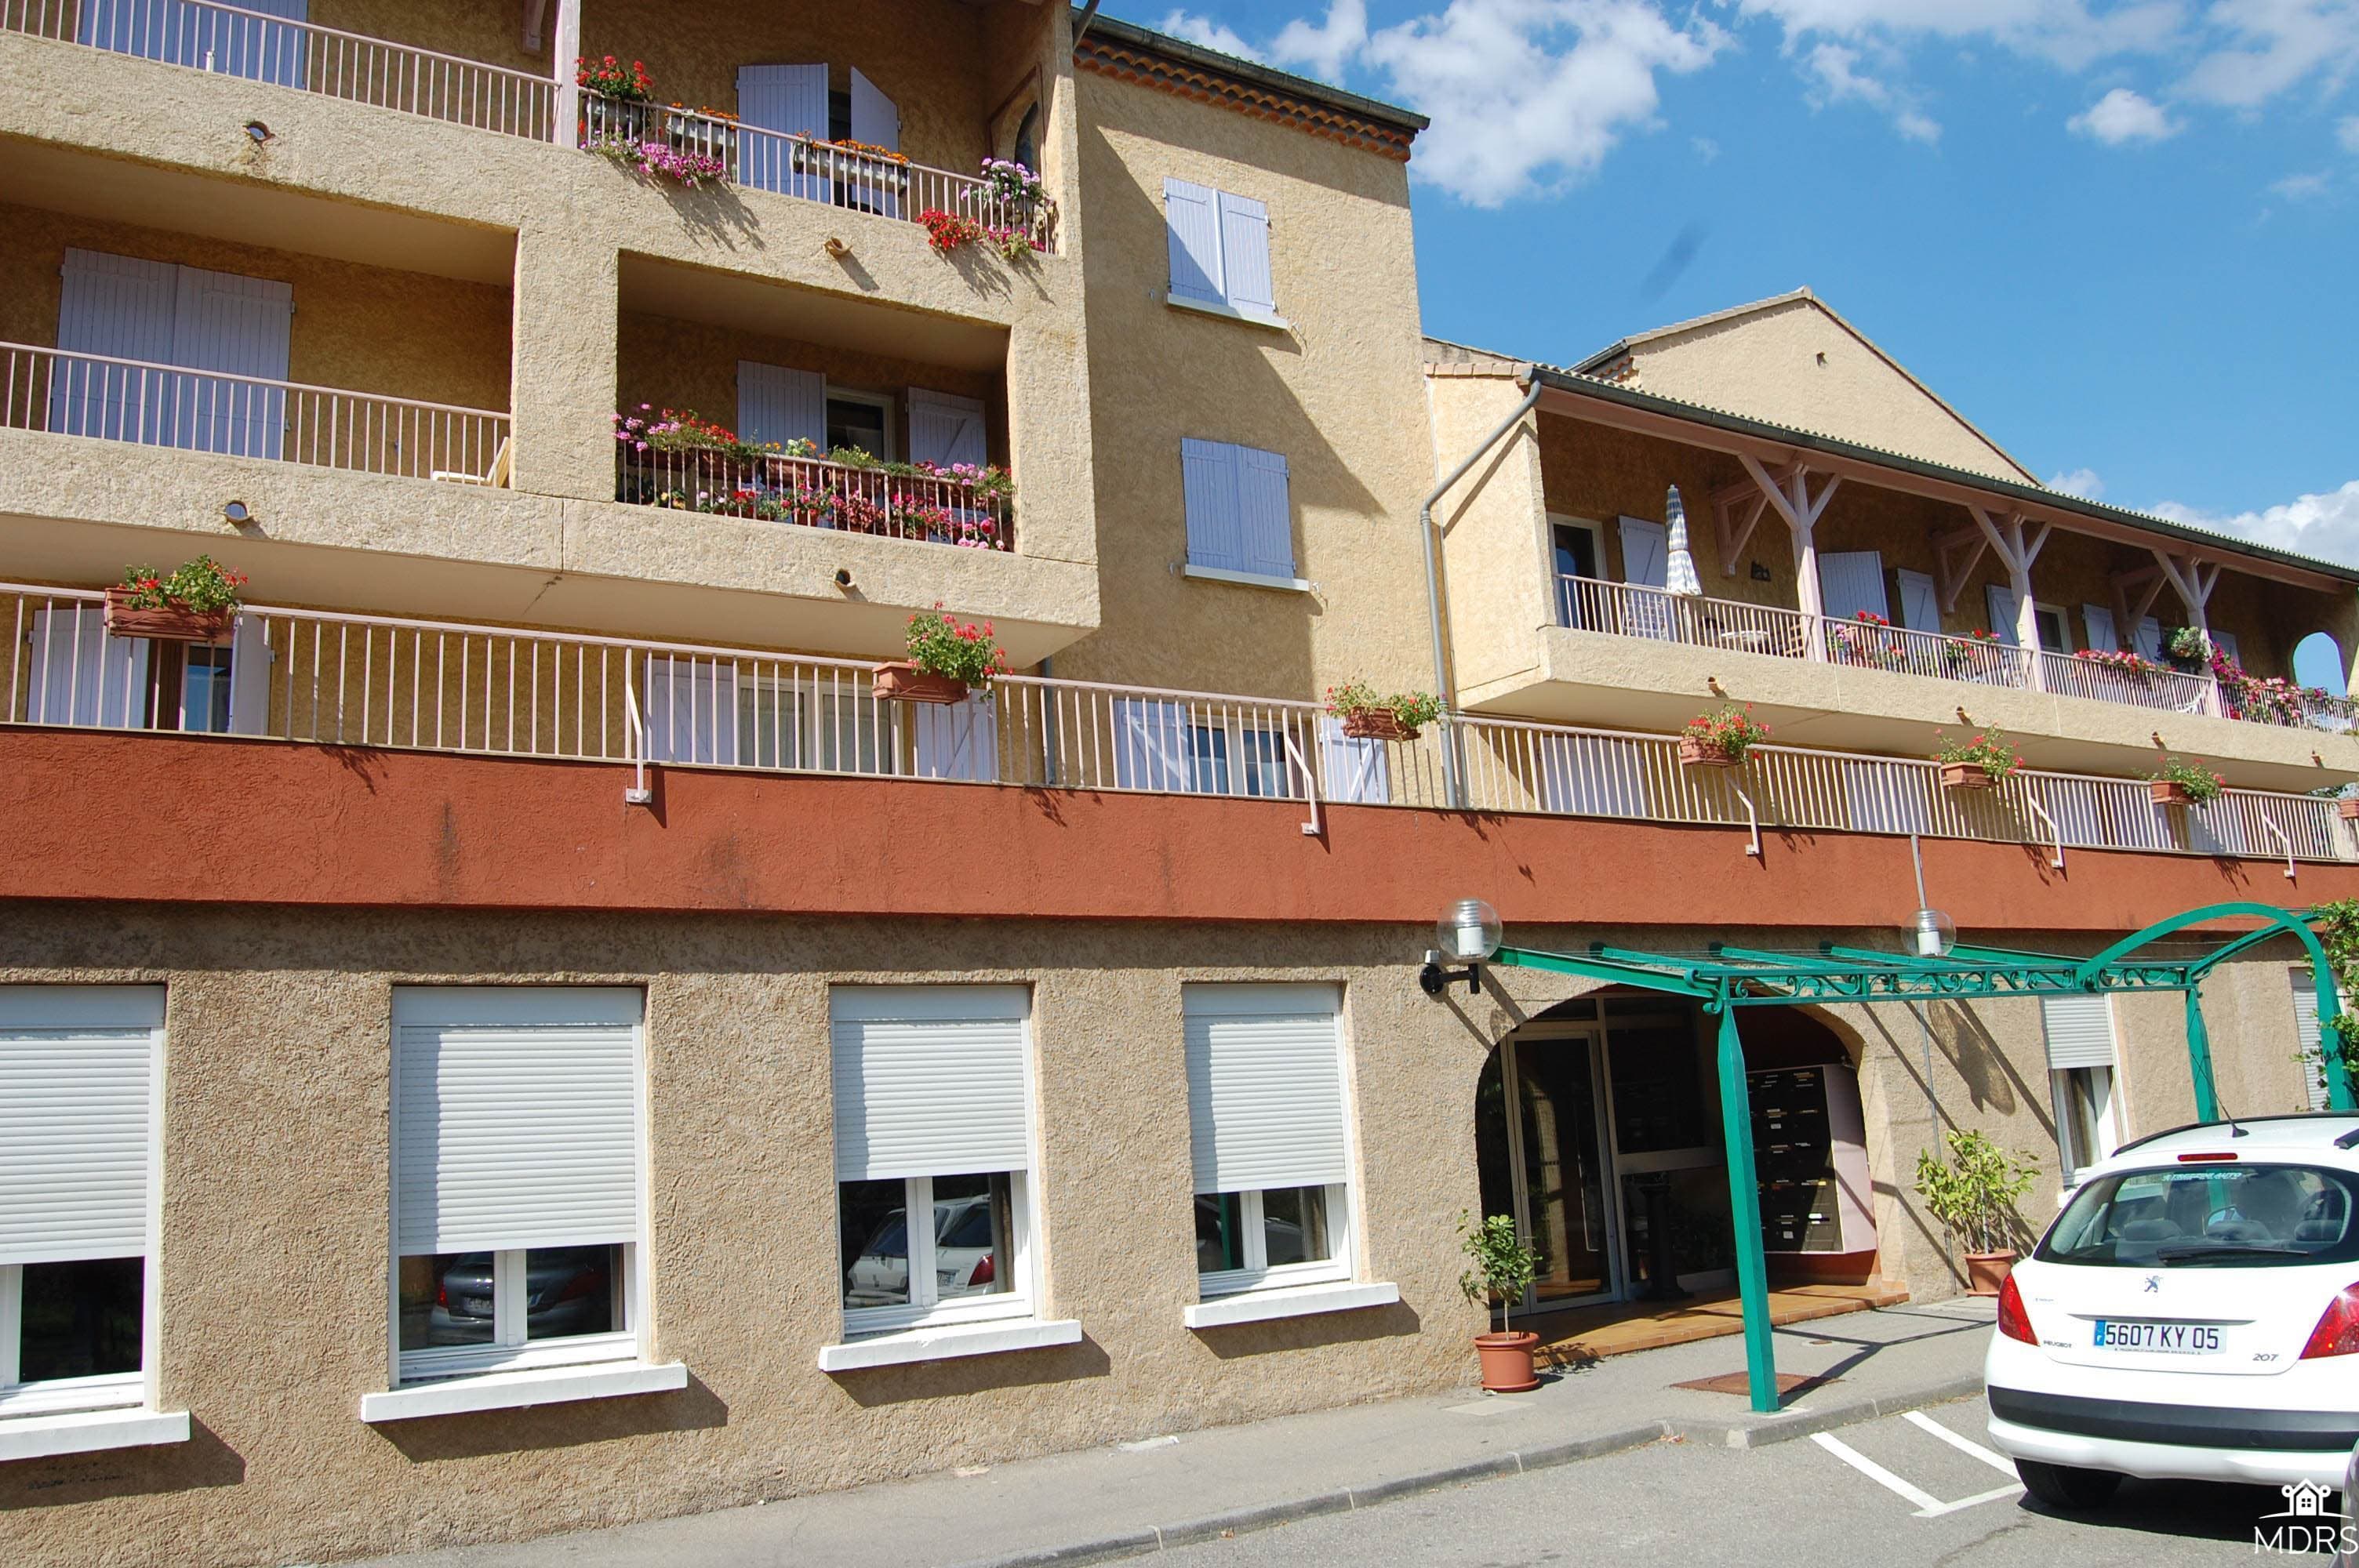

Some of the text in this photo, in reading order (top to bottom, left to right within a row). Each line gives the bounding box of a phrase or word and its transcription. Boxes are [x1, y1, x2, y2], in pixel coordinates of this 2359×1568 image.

[2044, 1340, 2072, 1348] PEUGEOT
[2106, 1324, 2219, 1349] 5607 KY 05
